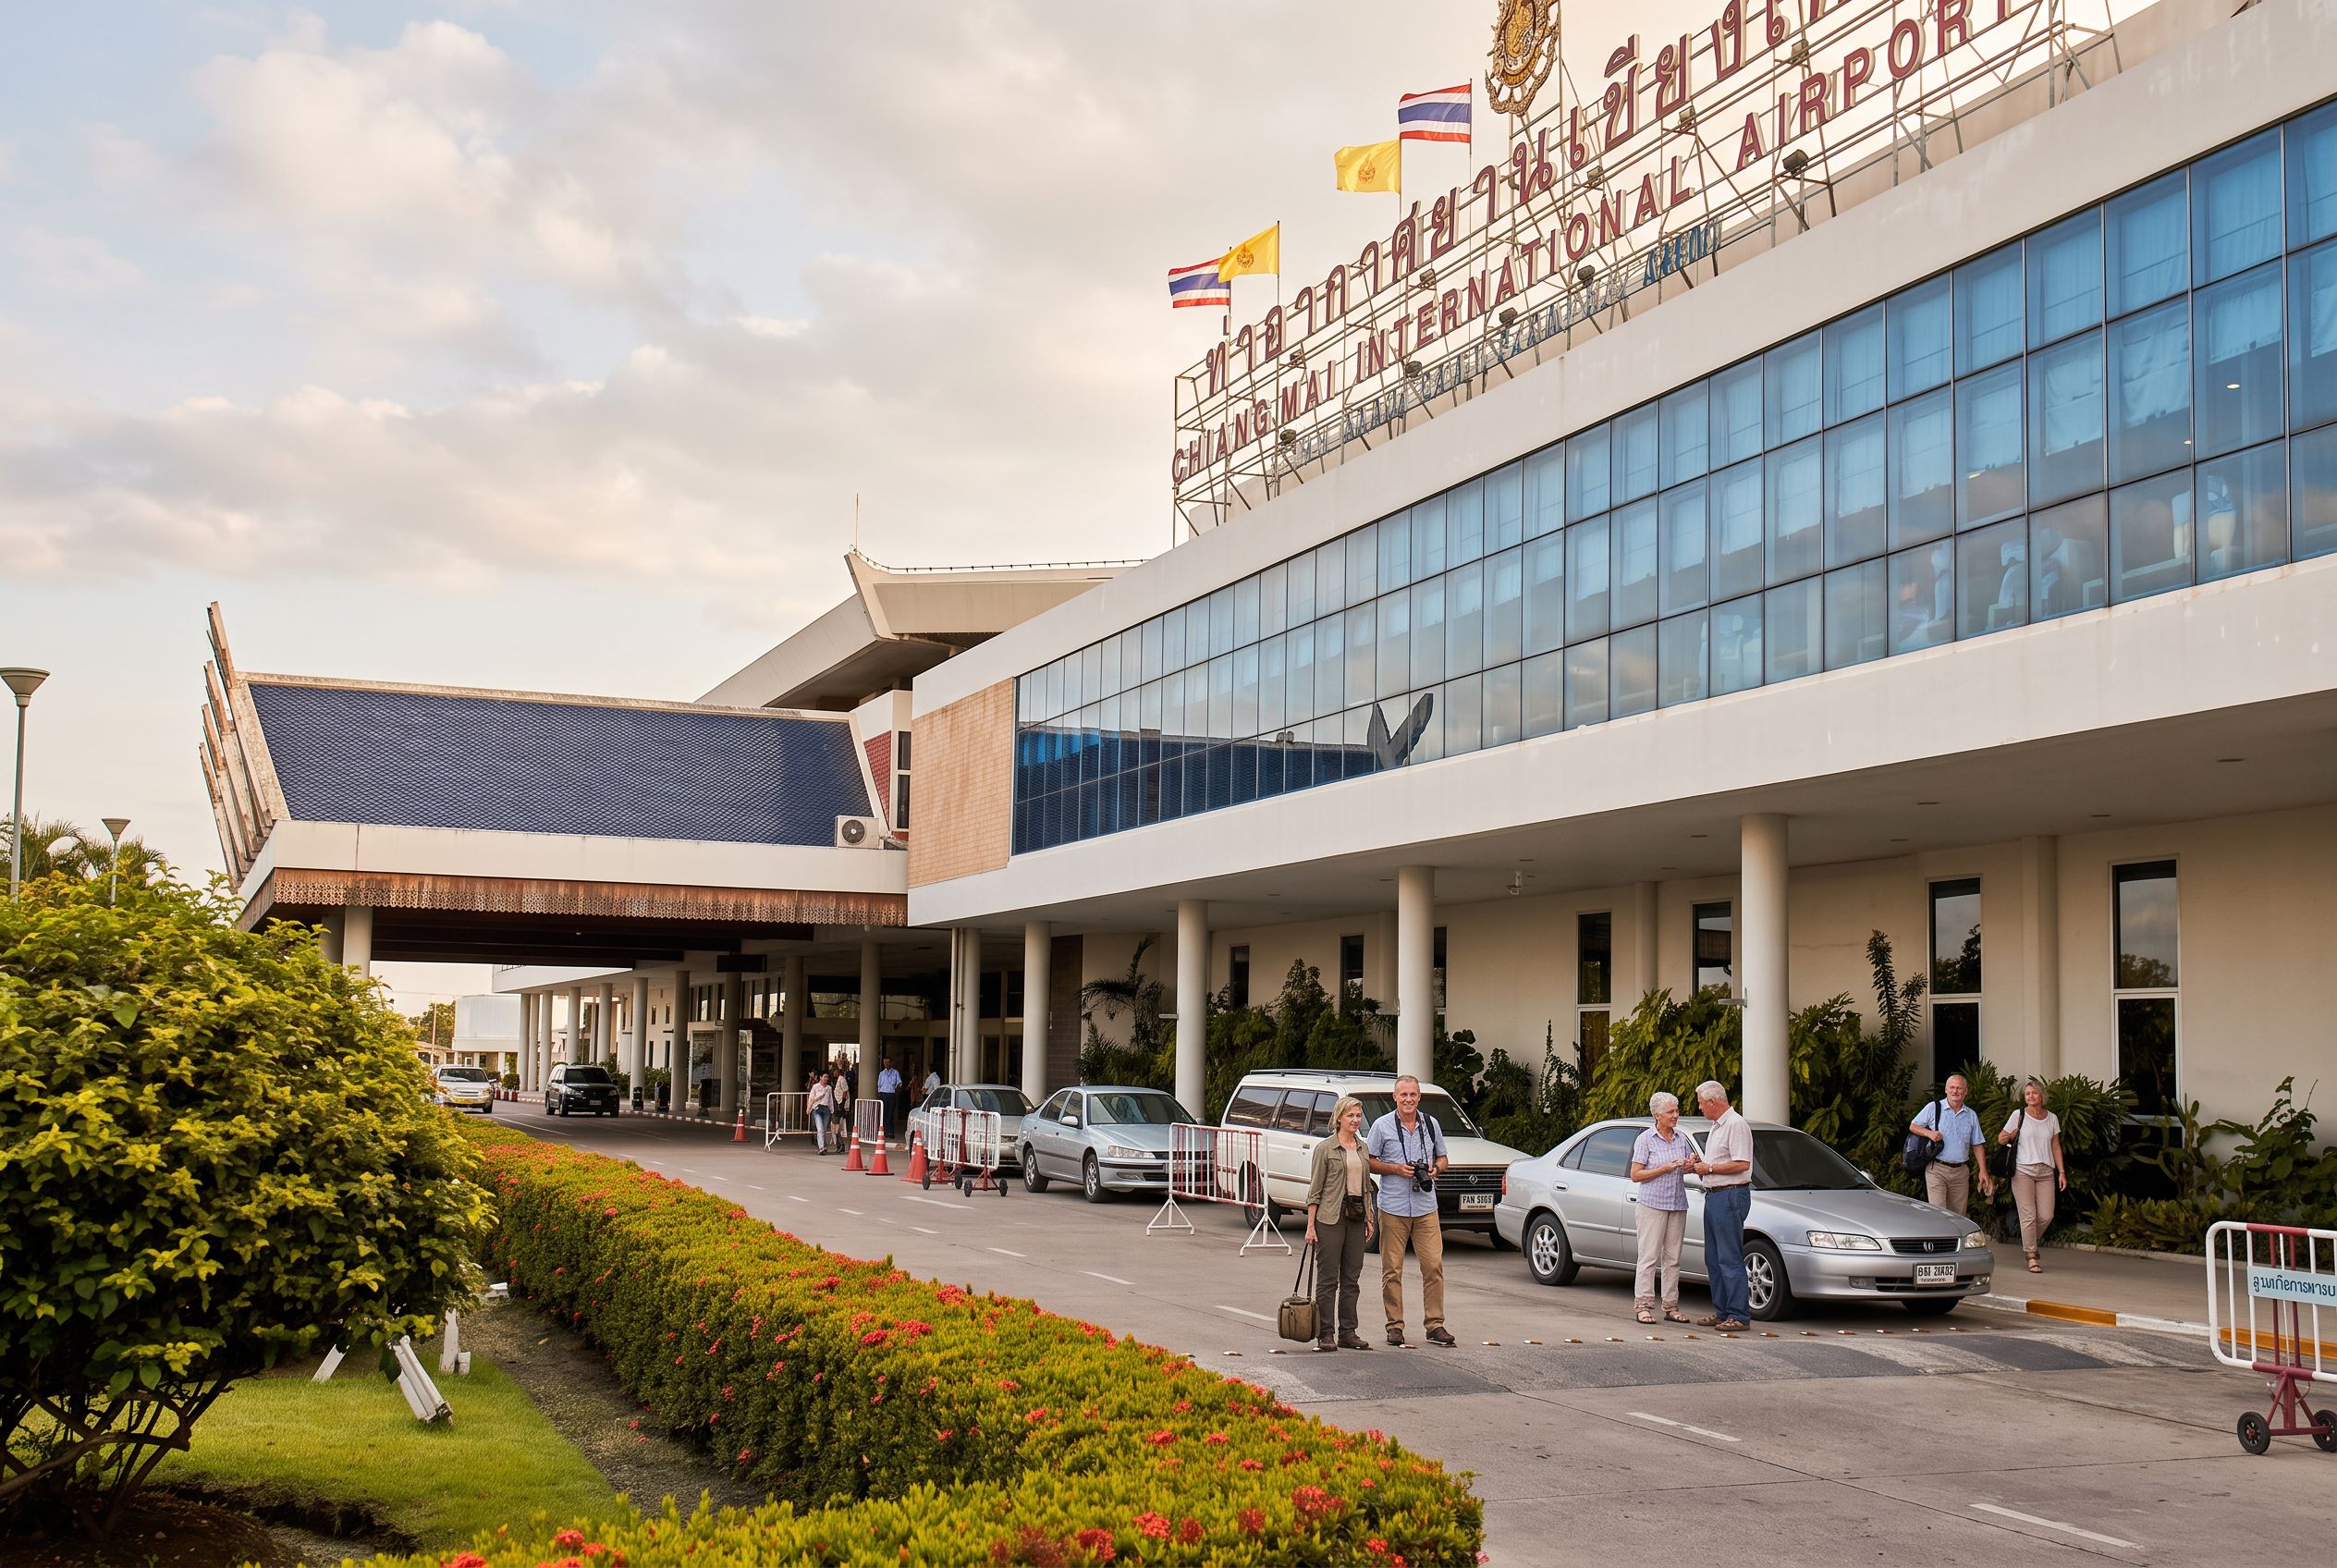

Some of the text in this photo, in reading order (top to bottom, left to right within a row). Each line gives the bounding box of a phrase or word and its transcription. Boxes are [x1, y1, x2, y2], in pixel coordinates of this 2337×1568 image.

[1172, 398, 1272, 484] CHIANG
[1280, 359, 1338, 425] MAI
[1356, 155, 1695, 384] INTERNATIONAL
